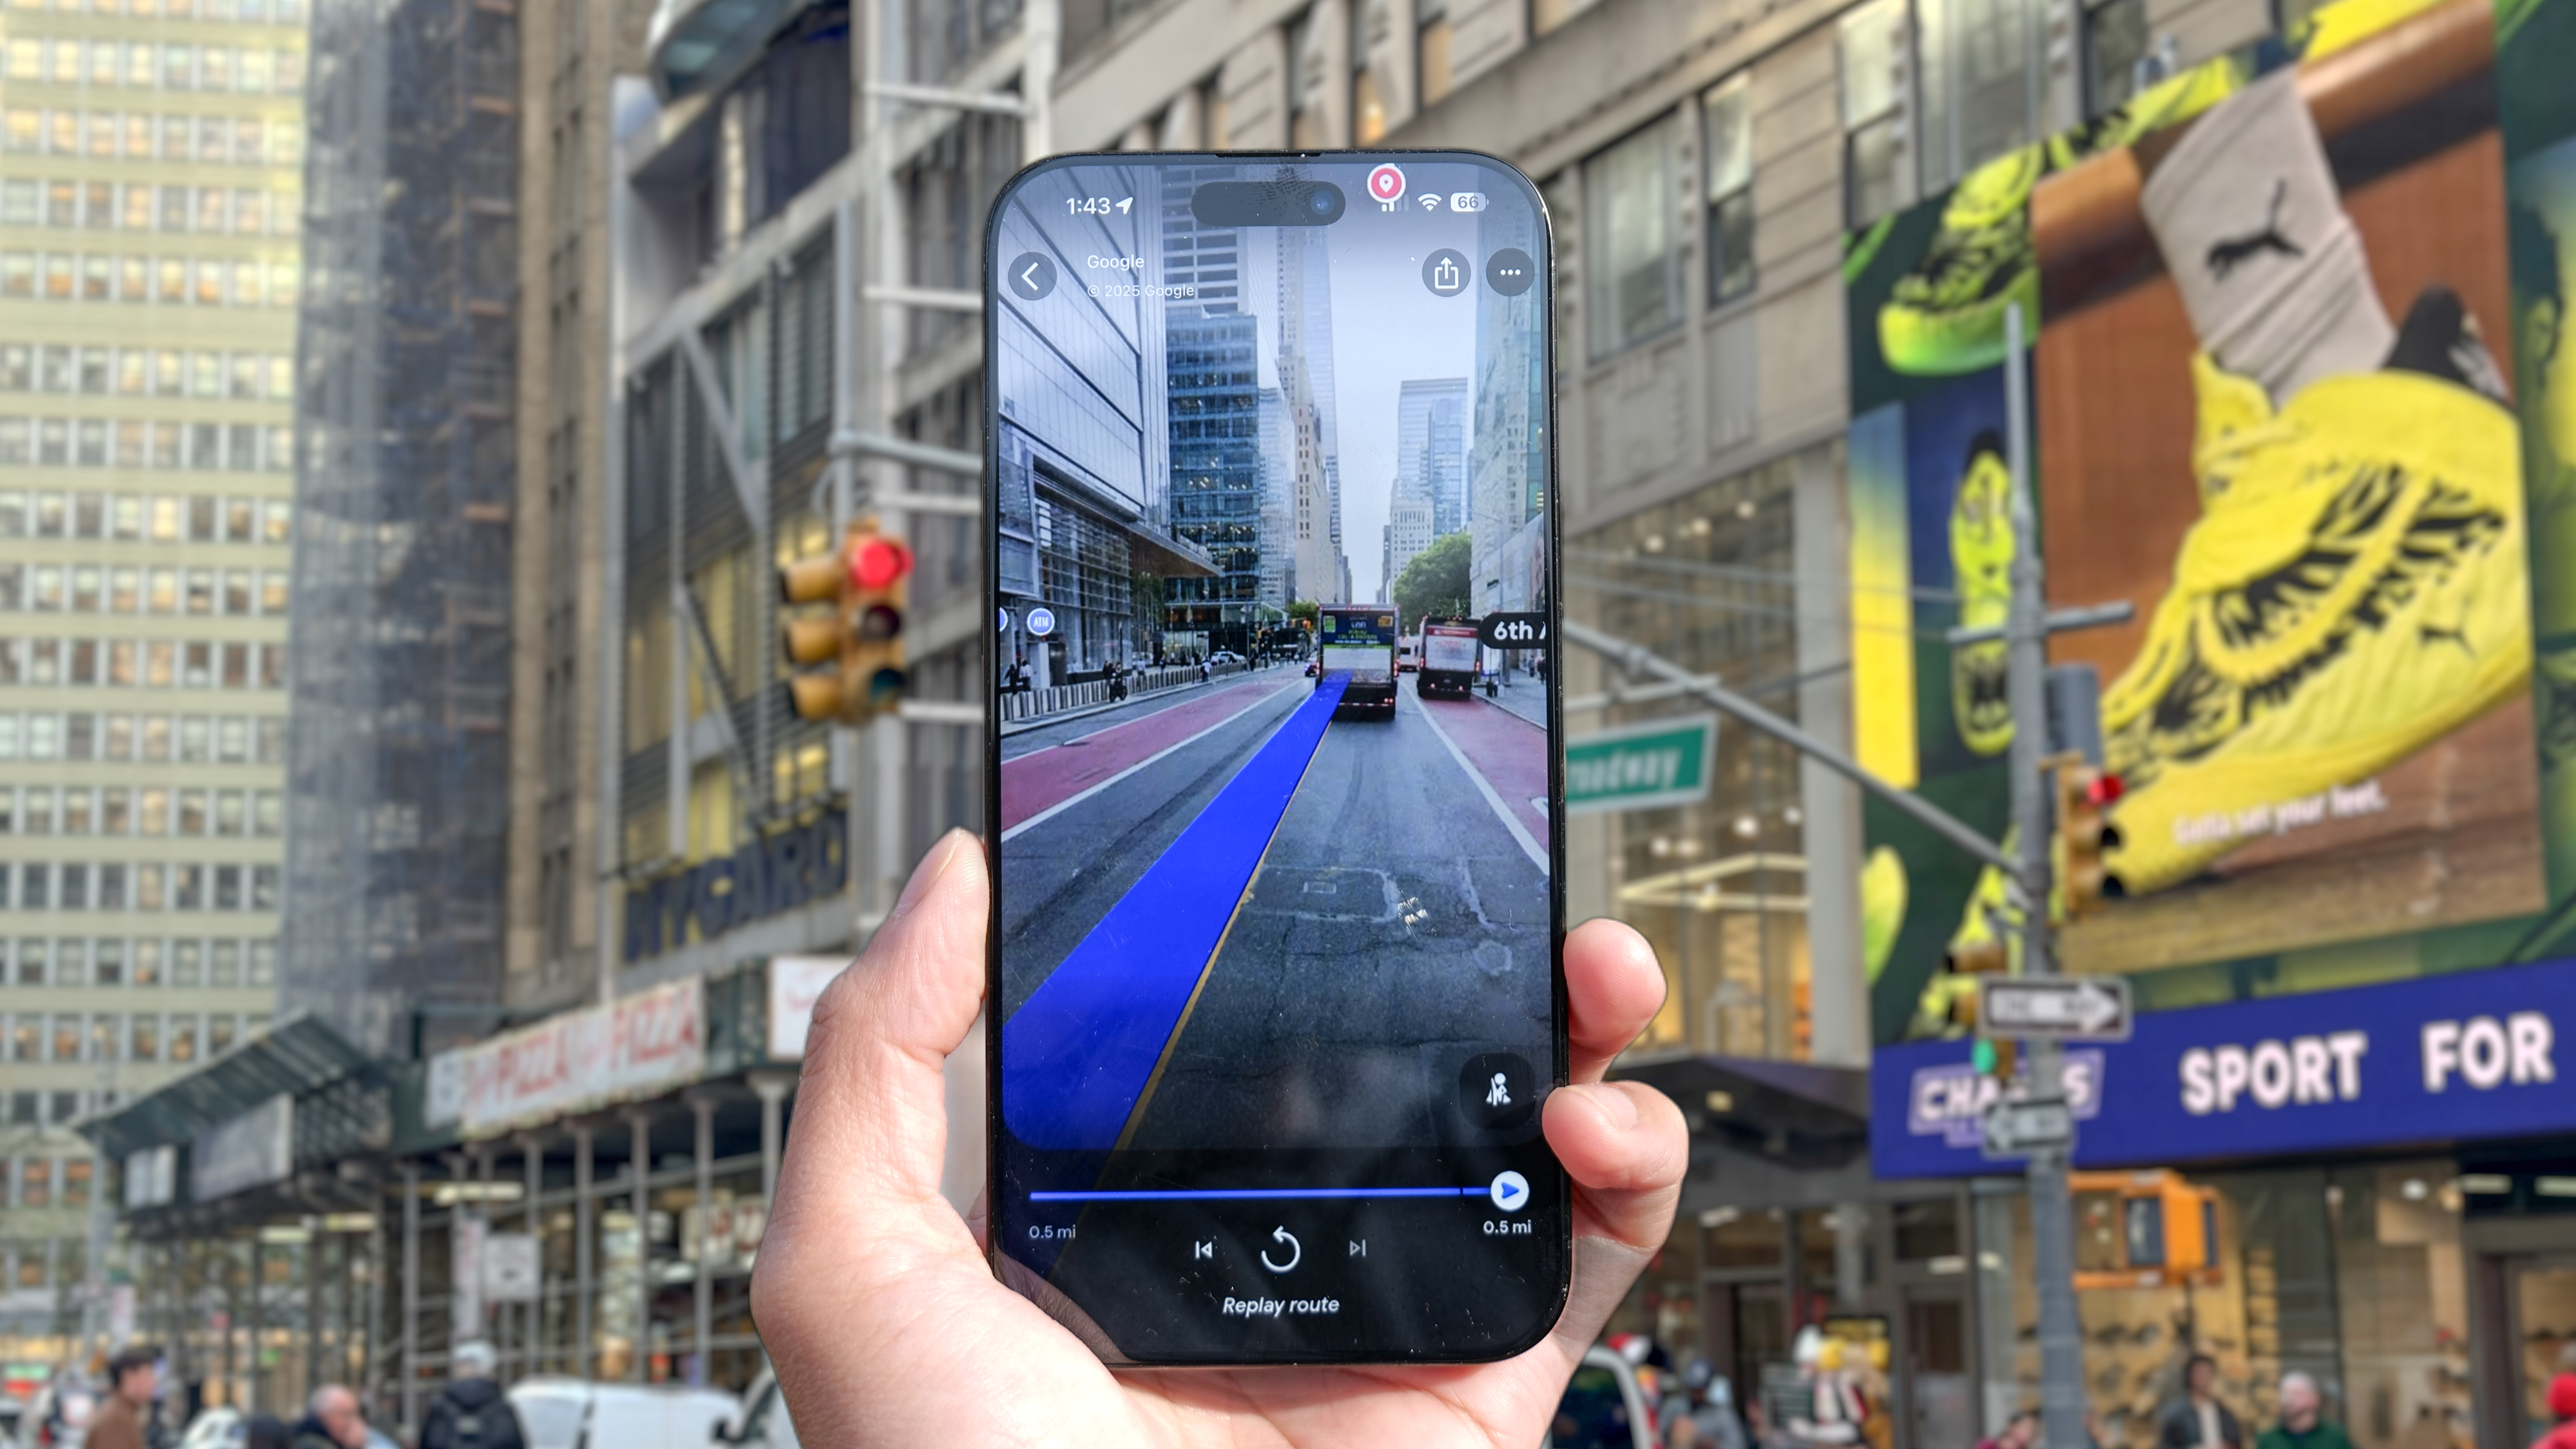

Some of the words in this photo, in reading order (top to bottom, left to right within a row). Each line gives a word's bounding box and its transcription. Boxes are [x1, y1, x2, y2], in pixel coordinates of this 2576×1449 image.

[1066, 197, 1111, 214] 1:43
[1458, 196, 1478, 209] 66
[1087, 254, 1145, 271] Google
[1105, 285, 1140, 297] 2025
[1145, 284, 1194, 298] Google
[1034, 616, 1049, 627] ATM
[1494, 620, 1533, 640] 6th
[1565, 749, 1681, 794] roadway
[612, 985, 699, 1074] PIZZA
[2179, 1030, 2369, 1116] SPORT
[2421, 1010, 2555, 1093] FOR
[1918, 1062, 2092, 1122] CHAS
[1029, 1225, 1053, 1238] 0.5
[1057, 1224, 1076, 1238] mi
[1483, 1220, 1509, 1234] 0.5
[1513, 1219, 1532, 1233] mi
[1223, 1296, 1285, 1318] Replay
[1289, 1296, 1339, 1313] route
